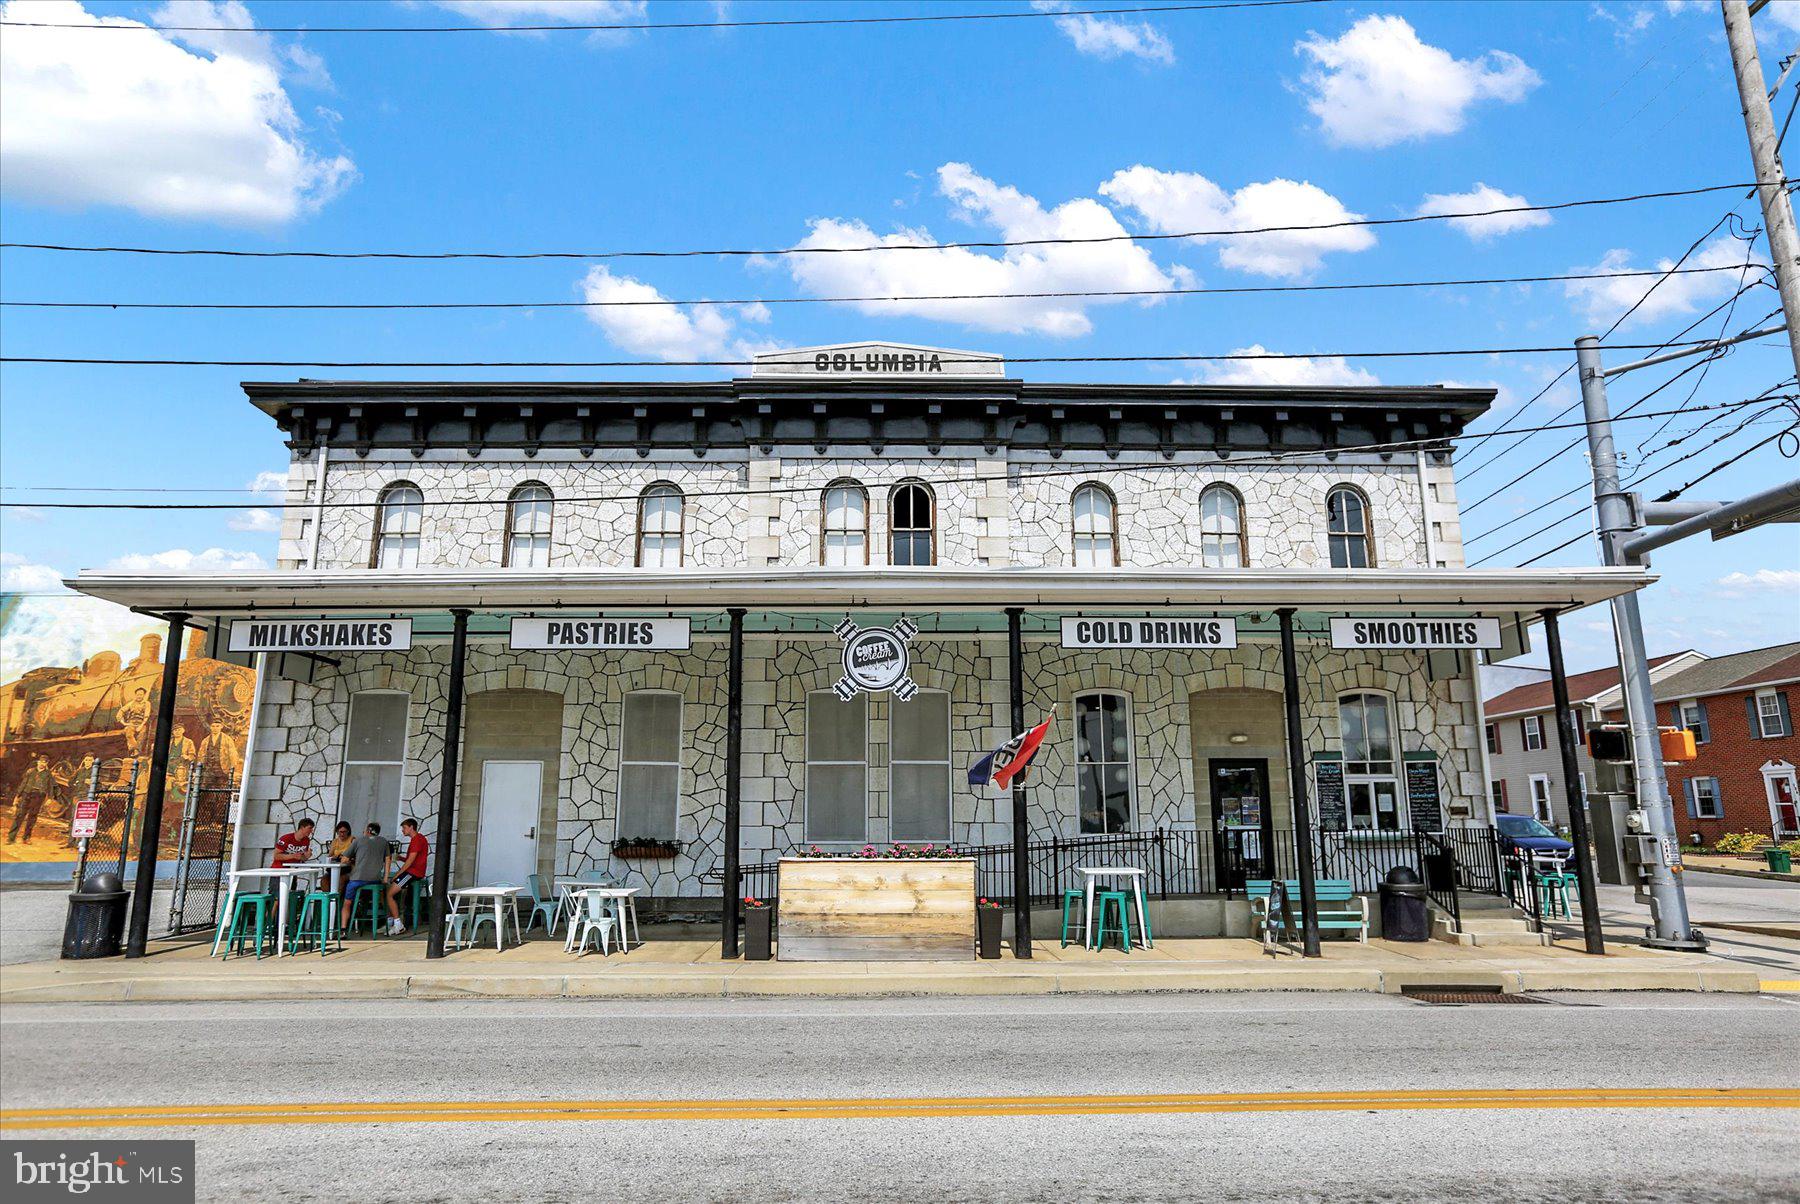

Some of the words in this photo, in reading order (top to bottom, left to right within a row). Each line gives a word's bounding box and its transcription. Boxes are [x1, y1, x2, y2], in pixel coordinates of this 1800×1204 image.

[815, 353, 943, 372] COLUMBIA
[249, 623, 393, 647] MILKSHAKES
[547, 622, 653, 645] PASTRIES
[1076, 621, 1133, 644] COLD
[1139, 622, 1222, 644] DRINKS
[1353, 622, 1478, 645] SMOOTHIES
[855, 641, 890, 657] COFFEE
